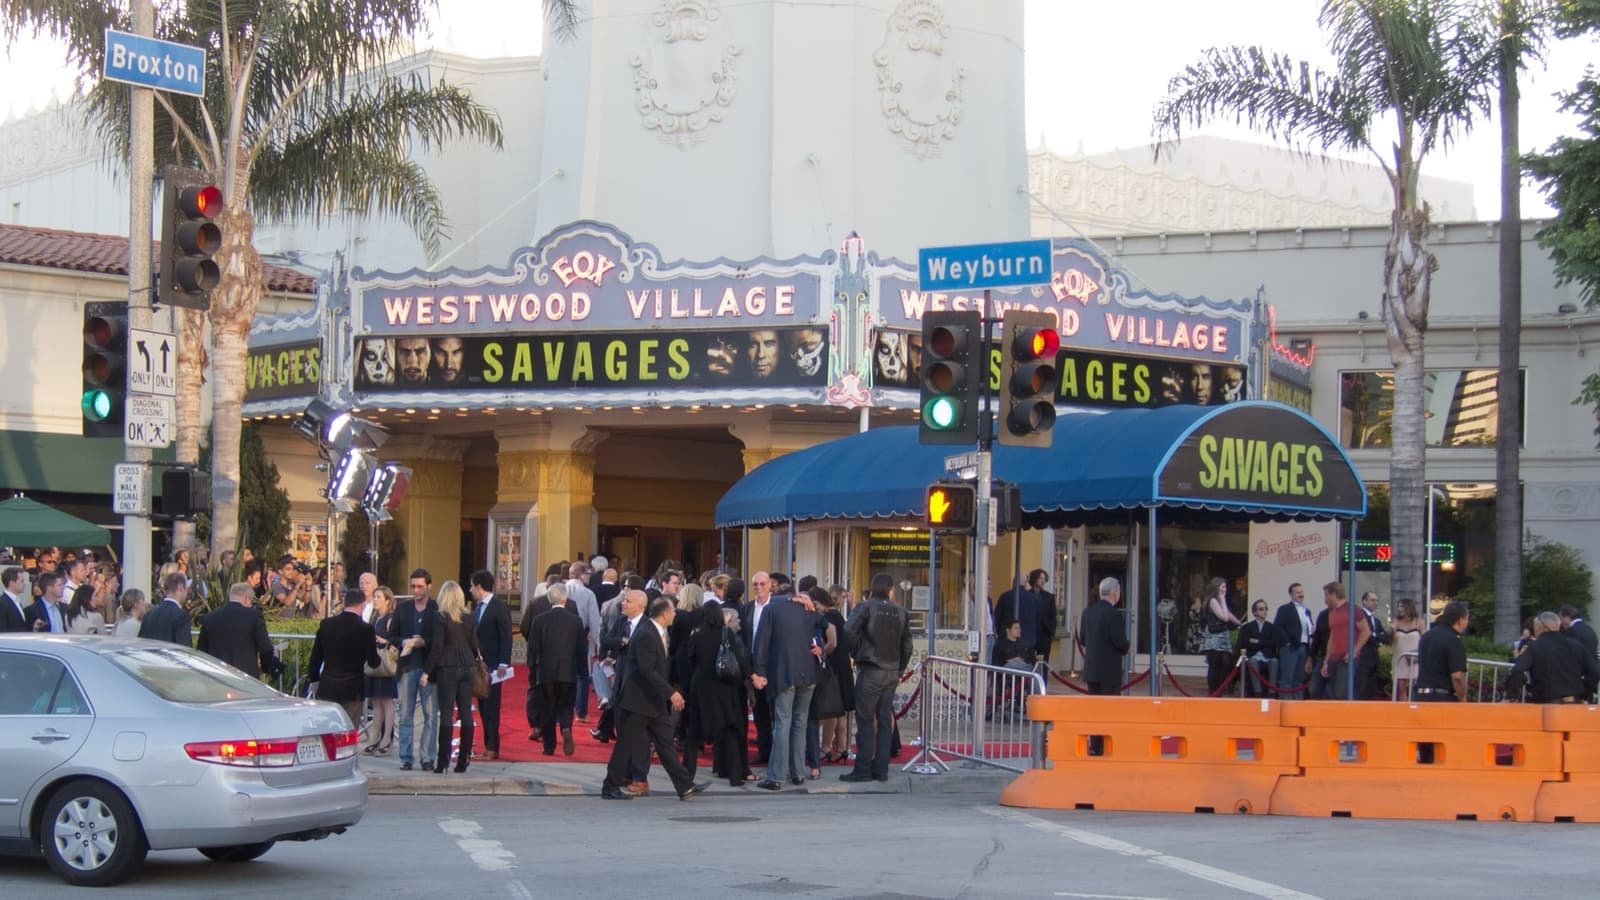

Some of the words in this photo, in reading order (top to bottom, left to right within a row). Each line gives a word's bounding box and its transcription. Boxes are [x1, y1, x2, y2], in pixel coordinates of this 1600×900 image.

[112, 42, 199, 84] Broxton
[551, 251, 616, 288] FOX
[927, 254, 1043, 284] Weyburn
[1050, 268, 1098, 306] FOX
[383, 291, 592, 325] WESTWOOD
[625, 284, 796, 320] VILLAGE
[898, 288, 1080, 337] WESTWD
[1104, 312, 1228, 353] VILLAGE
[247, 346, 320, 390] VAGES
[482, 338, 691, 383] SAVAGES
[132, 371, 151, 385] ONLY
[155, 374, 174, 389] ONLY
[989, 348, 1150, 404] SAGES
[132, 399, 162, 409] DIAGONAL
[132, 407, 164, 417] CROSSING
[128, 422, 144, 441] OK
[119, 466, 140, 475] CROSS
[1198, 434, 1324, 497] SAVAGES
[117, 491, 139, 501] SIGNAL
[120, 483, 137, 491] WALK
[119, 501, 136, 511] ONLY
[1255, 533, 1322, 559] American
[1278, 546, 1330, 567] Vintage
